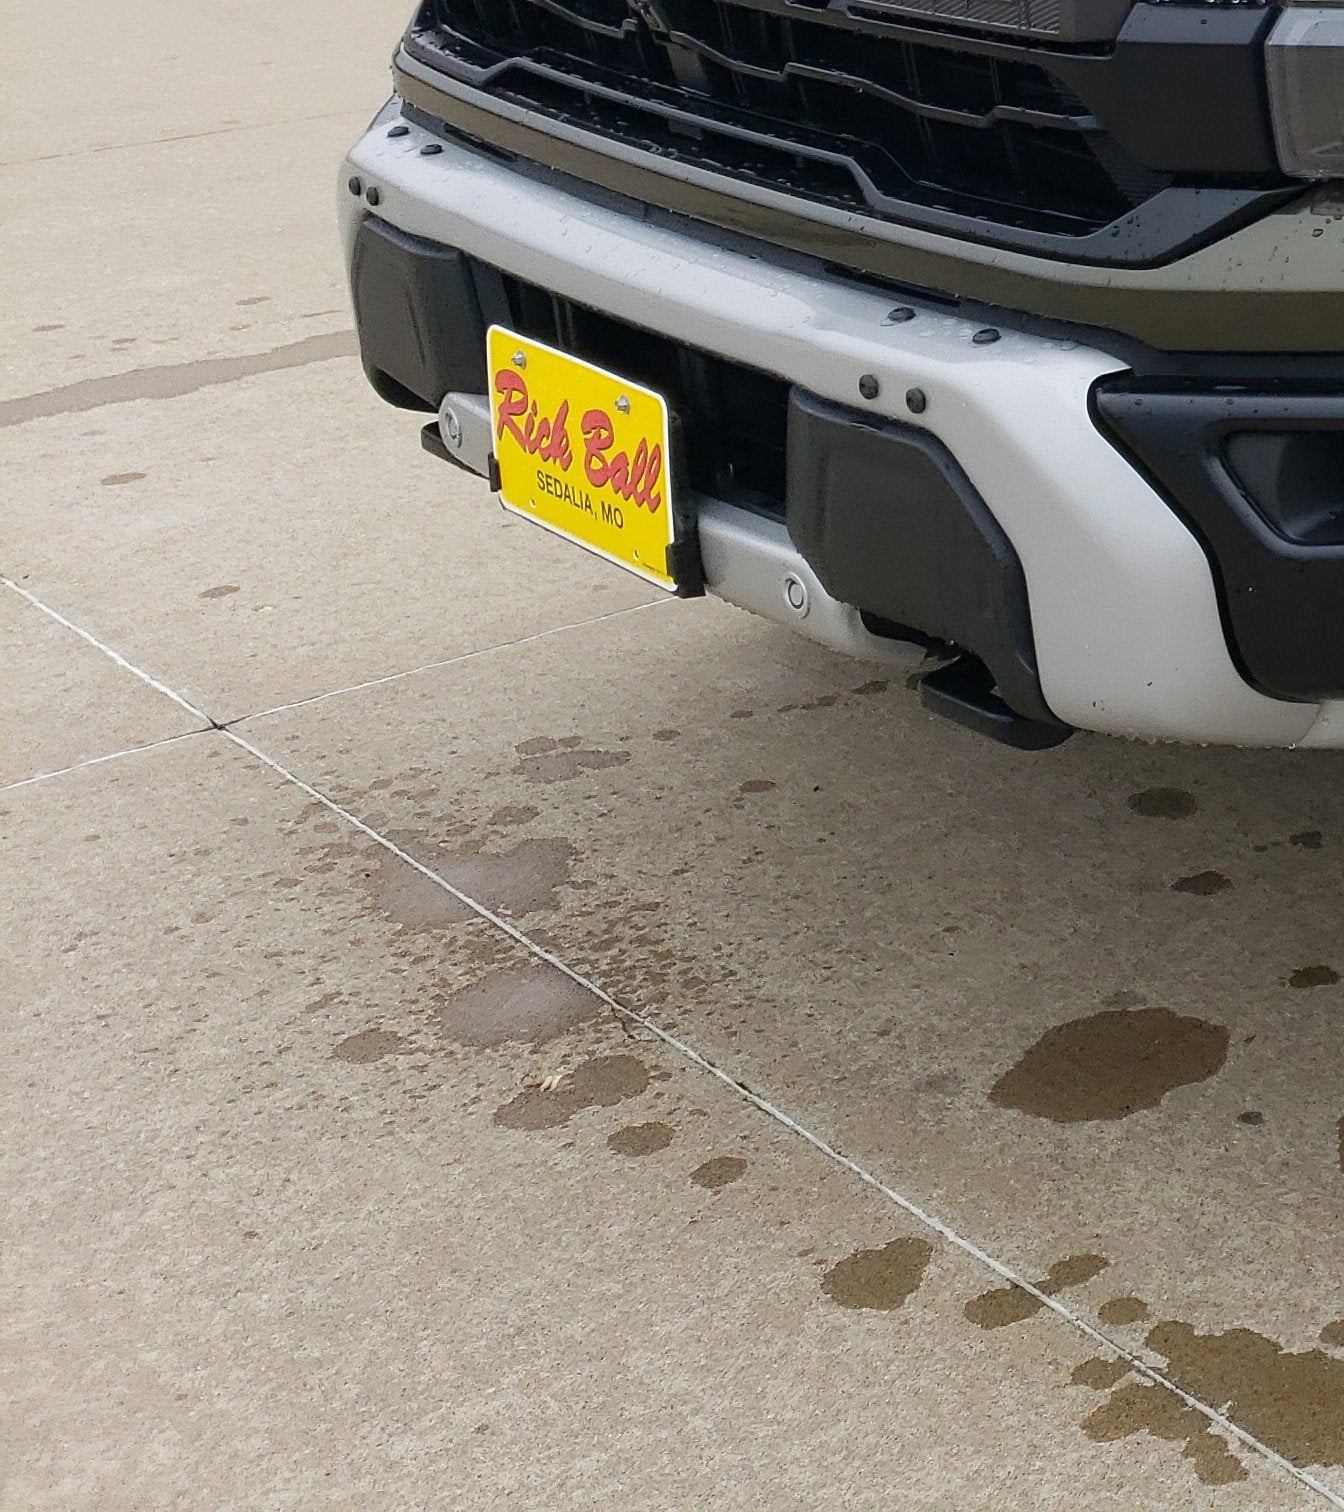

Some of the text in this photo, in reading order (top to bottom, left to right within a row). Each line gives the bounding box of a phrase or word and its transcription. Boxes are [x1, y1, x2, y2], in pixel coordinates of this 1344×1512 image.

[495, 368, 662, 514] Rick Ball
[536, 469, 624, 530] SEDALIA, MO
